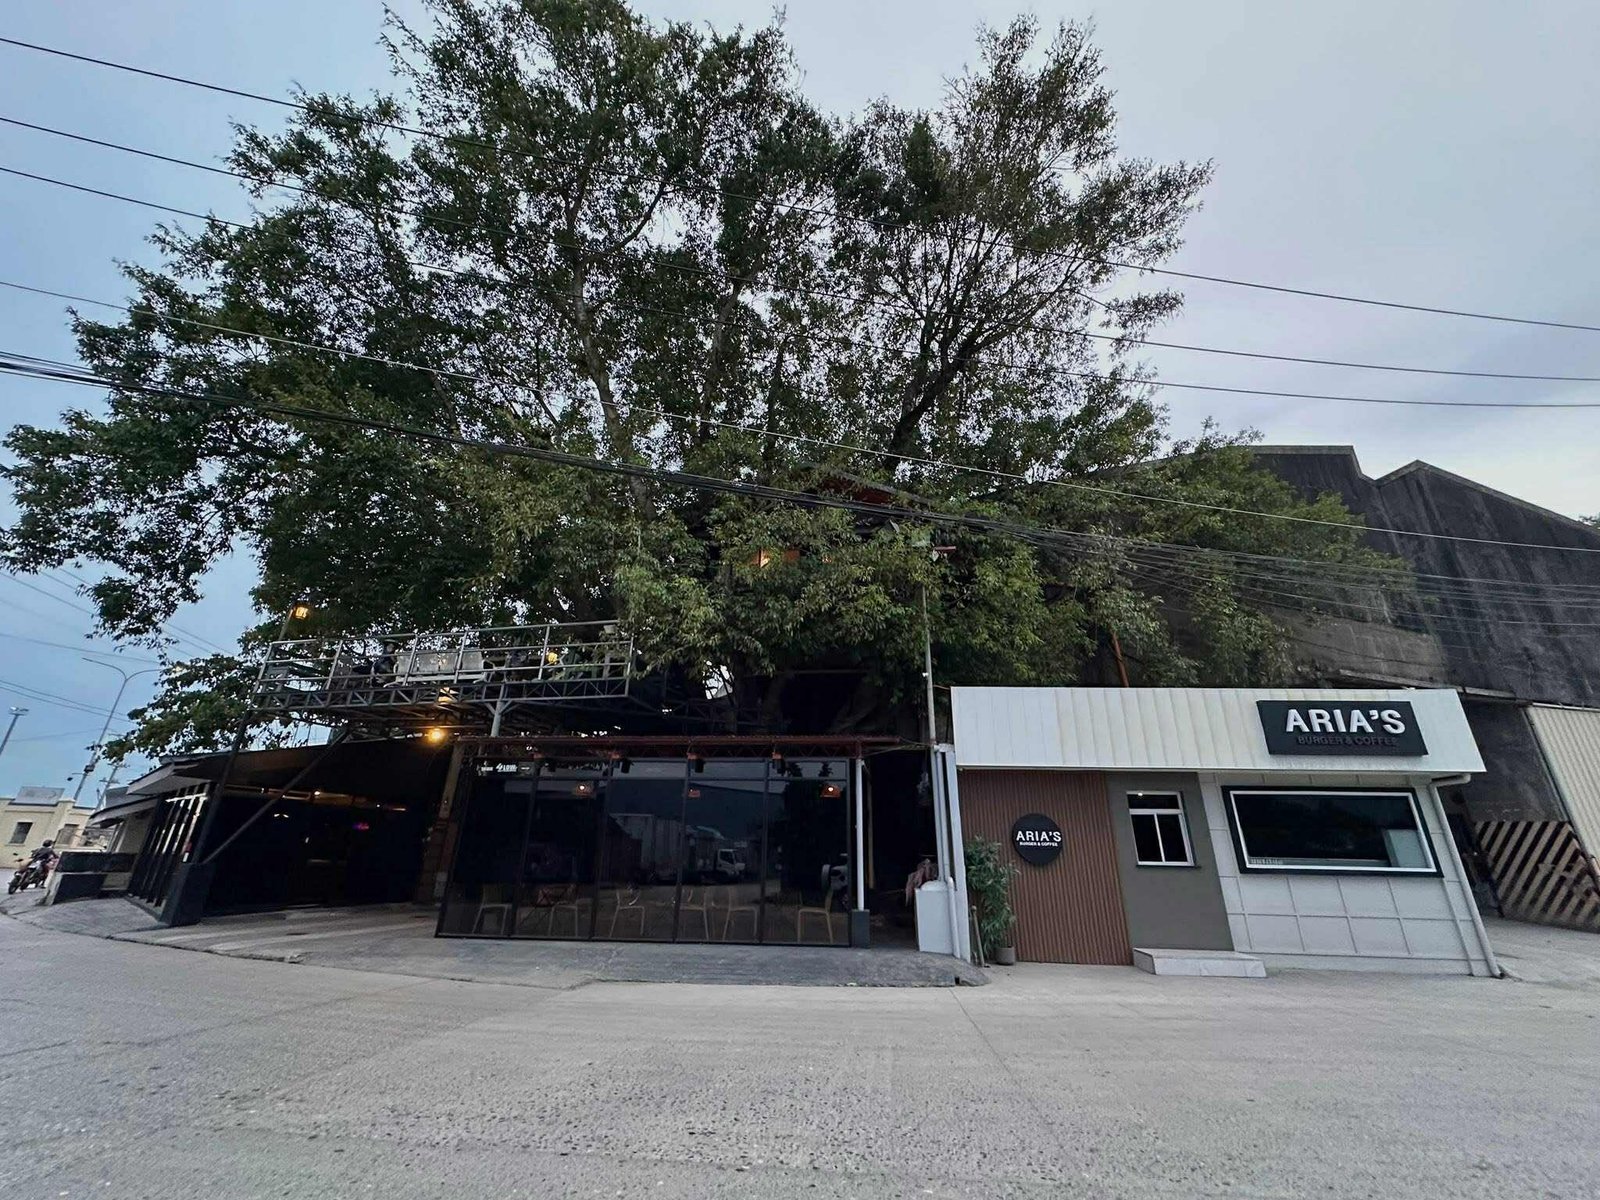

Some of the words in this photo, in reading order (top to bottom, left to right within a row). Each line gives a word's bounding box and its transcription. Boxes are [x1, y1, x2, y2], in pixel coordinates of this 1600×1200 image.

[1285, 708, 1406, 734] ARIA'S
[1298, 736, 1343, 745] BURGER
[1355, 736, 1399, 746] COFFEE
[1016, 830, 1061, 841] ARIA'S
